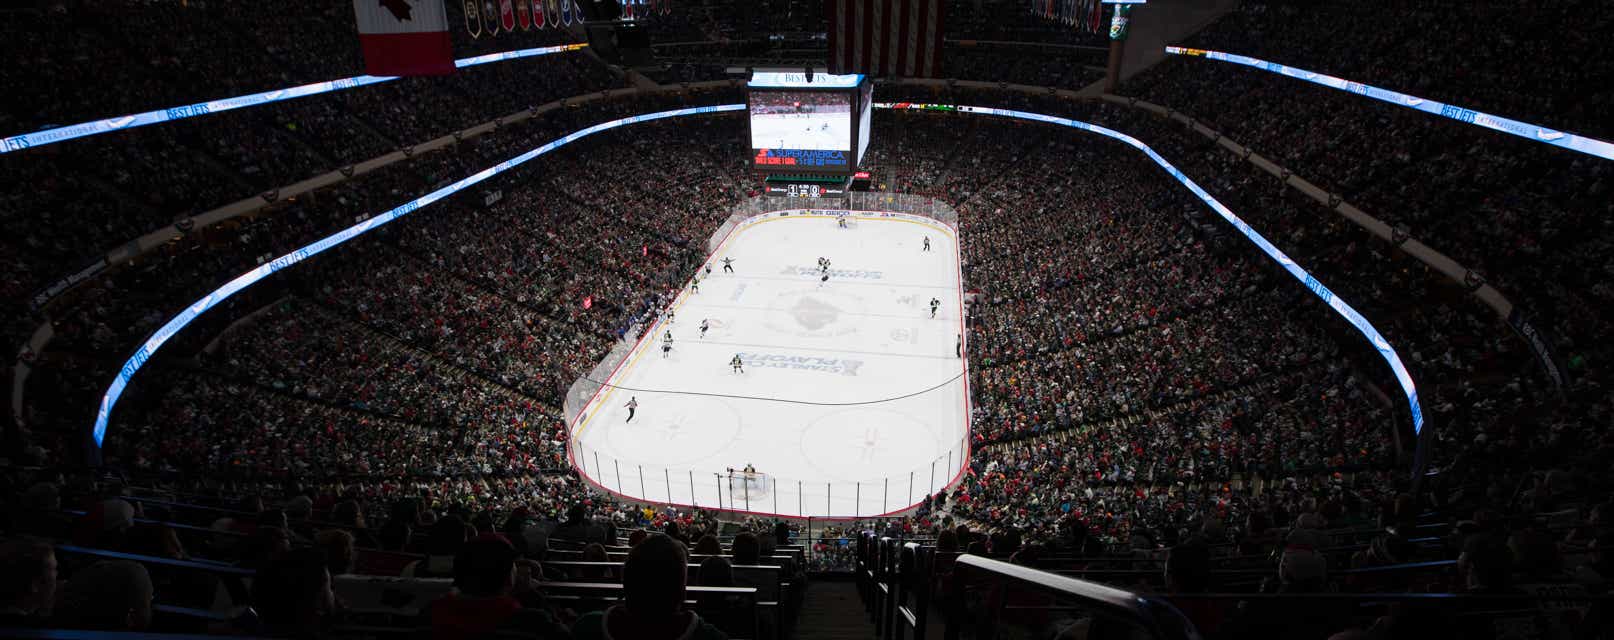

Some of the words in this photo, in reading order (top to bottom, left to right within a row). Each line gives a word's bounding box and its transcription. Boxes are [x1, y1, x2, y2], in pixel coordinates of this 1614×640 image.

[1442, 104, 1461, 119] BEST
[1460, 109, 1477, 123] JETS
[1478, 117, 1529, 135] INTERNATIONAL
[32, 126, 97, 144] INTERNATIONAL
